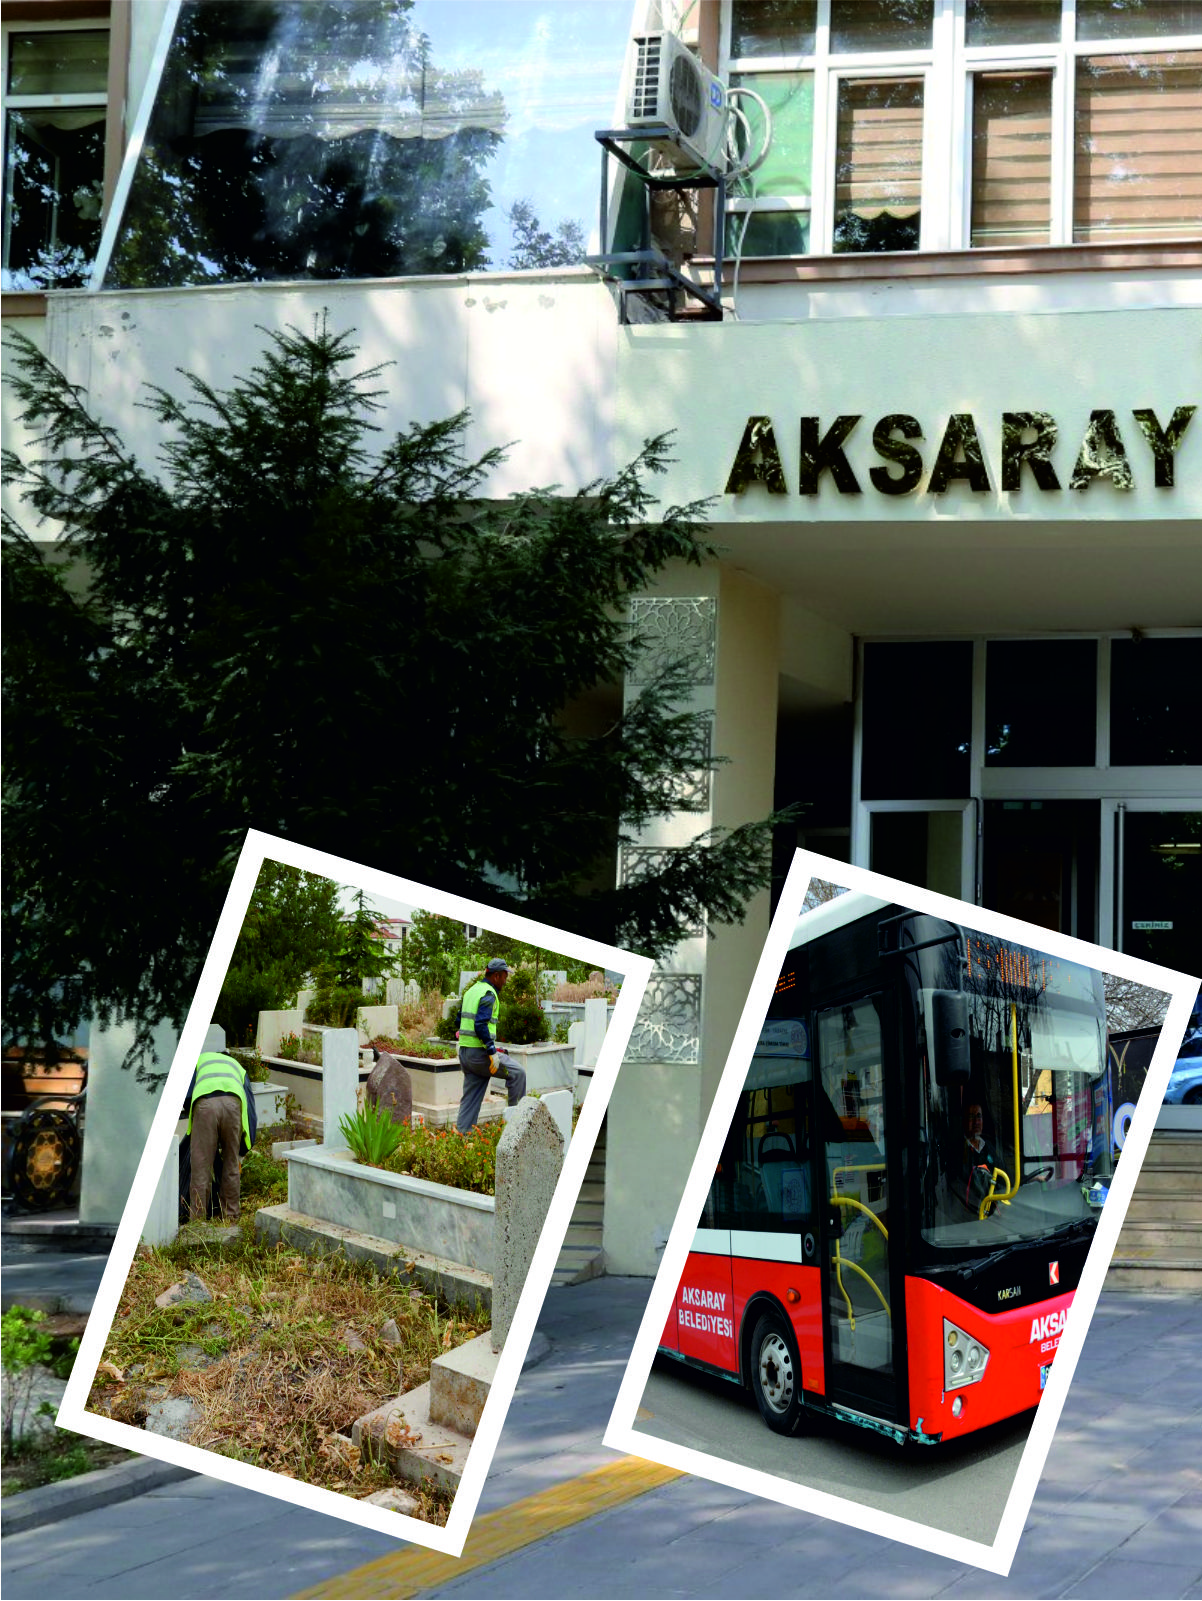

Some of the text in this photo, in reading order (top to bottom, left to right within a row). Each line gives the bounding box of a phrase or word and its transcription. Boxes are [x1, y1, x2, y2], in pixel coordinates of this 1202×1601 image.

[725, 405, 1198, 495] AKSARAY
[682, 1286, 726, 1312] AKSARAY
[997, 1286, 1022, 1301] KARSAN
[1029, 1306, 1071, 1344] AKSA
